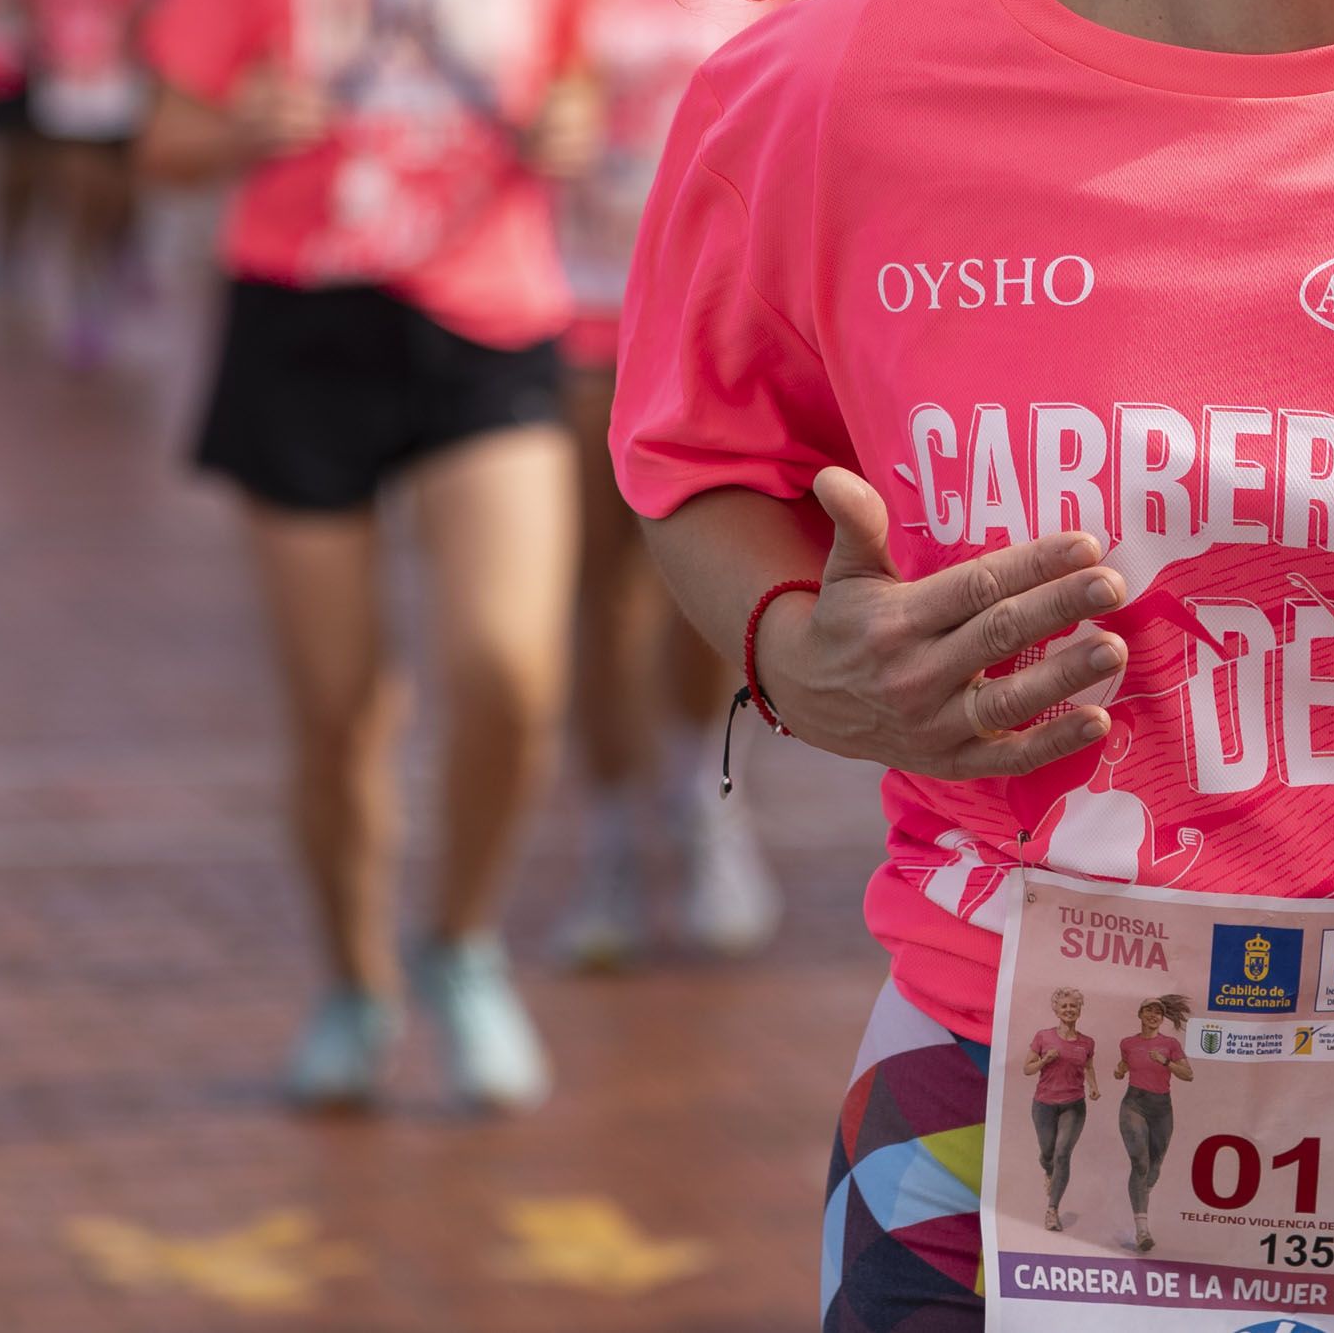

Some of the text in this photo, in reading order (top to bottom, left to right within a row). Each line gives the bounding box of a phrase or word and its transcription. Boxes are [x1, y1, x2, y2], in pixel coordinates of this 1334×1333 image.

[877, 254, 1095, 313] OYSHO
[1058, 906, 1170, 940] TU DORSAL
[1059, 927, 1170, 972] SUMA
[1215, 994, 1292, 1008] Gran Canaria
[1221, 983, 1285, 997] Cabildo de
[1226, 1032, 1283, 1042] Ayuntamiento
[1179, 1211, 1246, 1226] TELÉFONO
[1248, 1217, 1316, 1230] VIOLENCIA
[1013, 1264, 1138, 1296] CARRERA
[1145, 1271, 1180, 1298] DE
[1189, 1273, 1223, 1300] LA
[1232, 1277, 1328, 1306] MUJER
